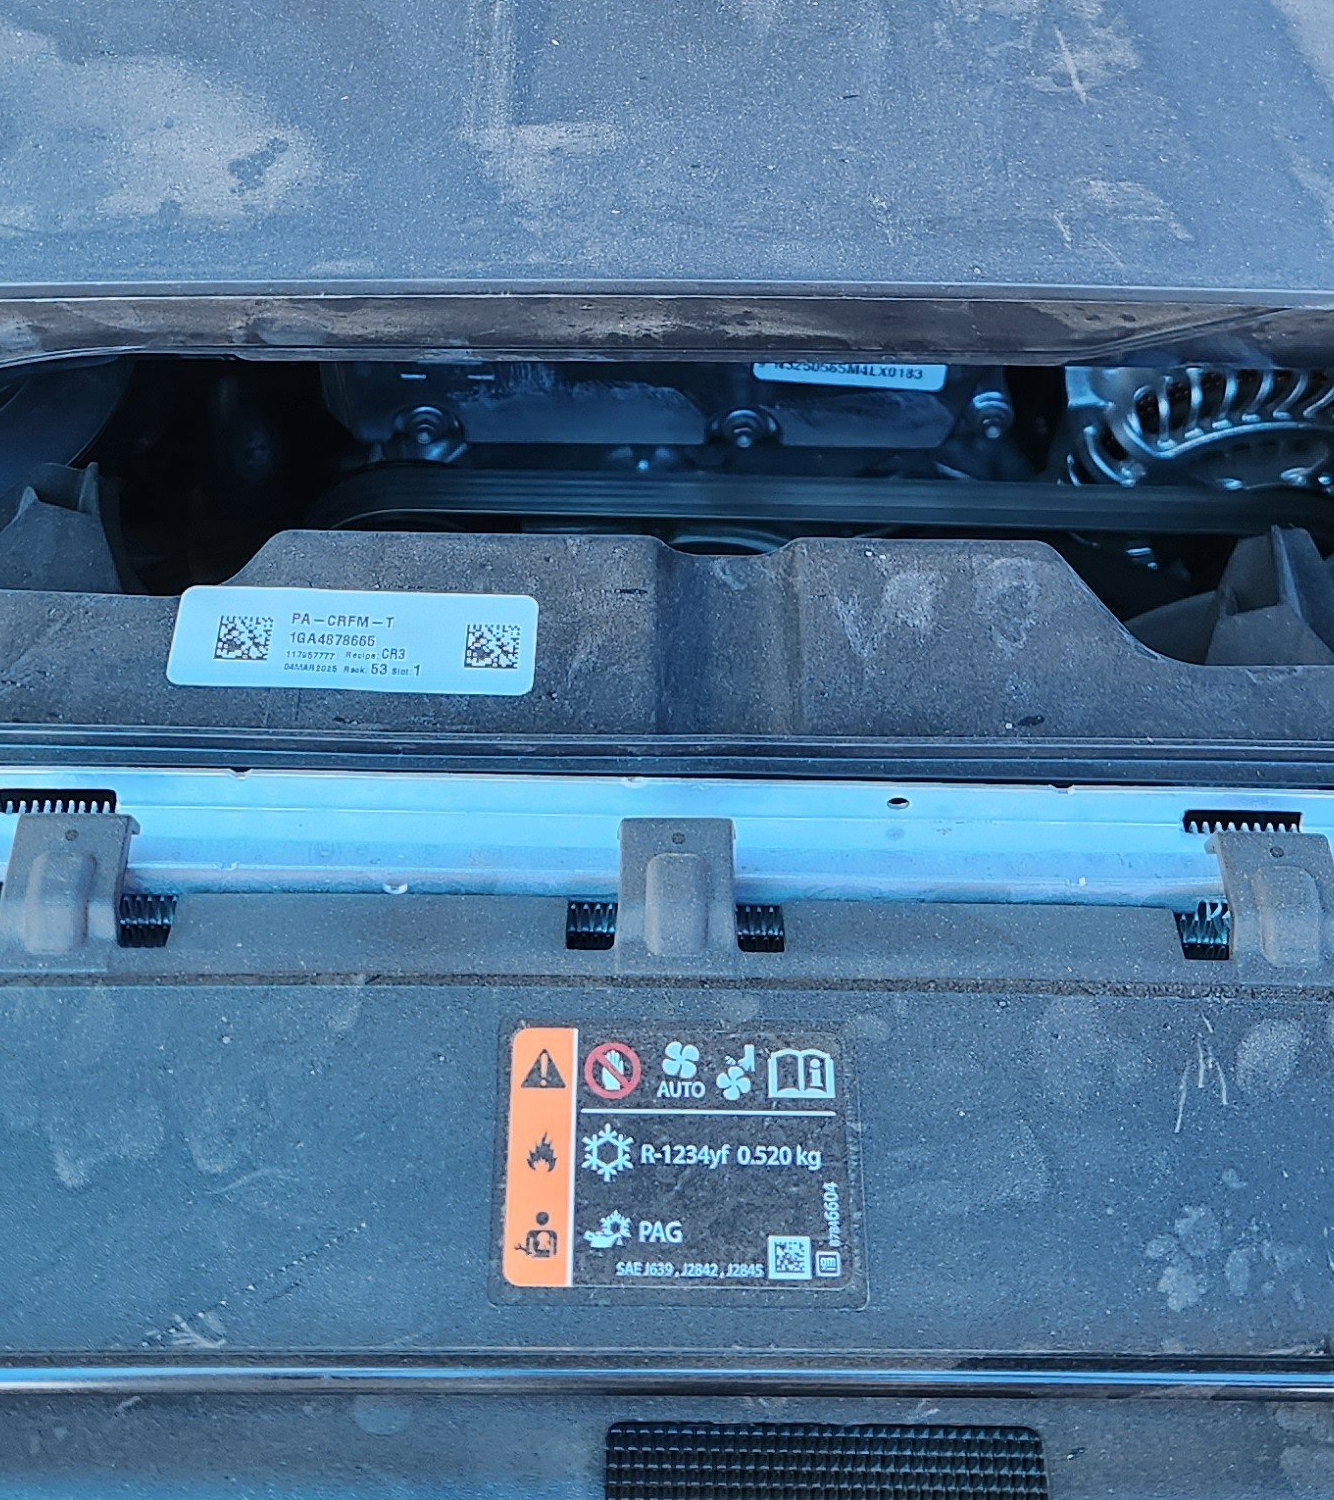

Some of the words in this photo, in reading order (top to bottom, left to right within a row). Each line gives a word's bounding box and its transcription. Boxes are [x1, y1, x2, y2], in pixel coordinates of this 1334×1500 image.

[381, 647, 406, 660] CR3
[371, 663, 388, 676] 53
[413, 664, 420, 677] 1
[656, 1080, 706, 1098] AUTO
[640, 1144, 732, 1170] R-1234yf
[737, 1145, 792, 1166] 0.520
[796, 1144, 823, 1171] kg
[638, 1220, 684, 1243] PAG
[615, 1261, 643, 1277] SAE
[725, 1262, 766, 1278] J2845
